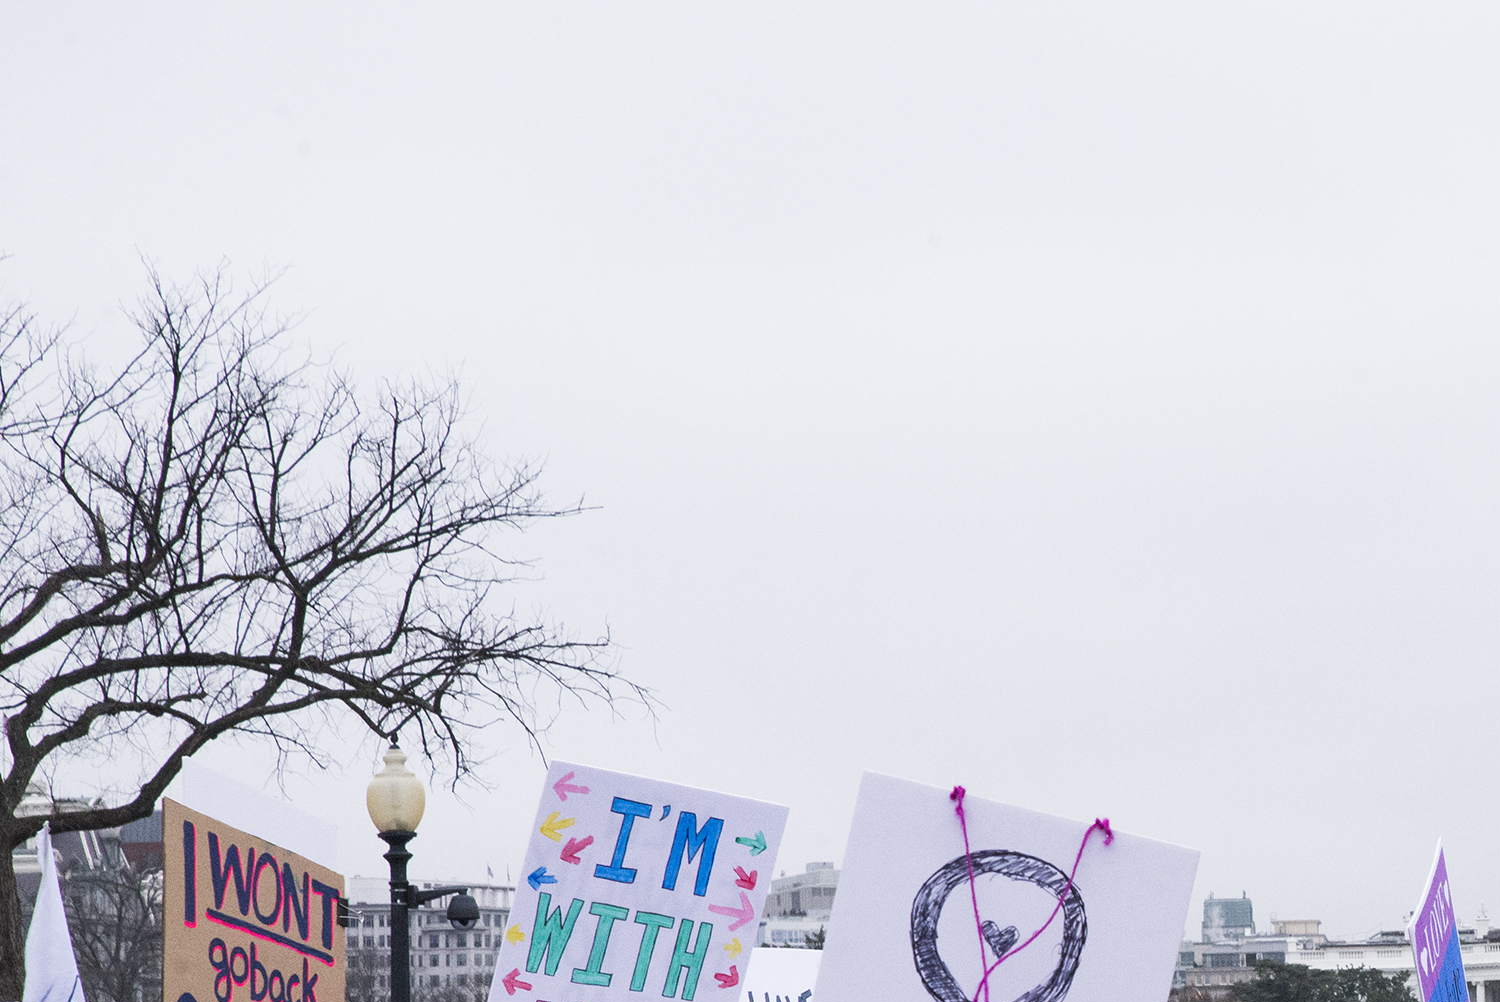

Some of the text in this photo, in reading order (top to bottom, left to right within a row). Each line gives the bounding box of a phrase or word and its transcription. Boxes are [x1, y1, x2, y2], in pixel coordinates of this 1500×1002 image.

[183, 820, 341, 950] I WONT
[594, 796, 724, 897] I'M
[525, 892, 713, 1001] WITH
